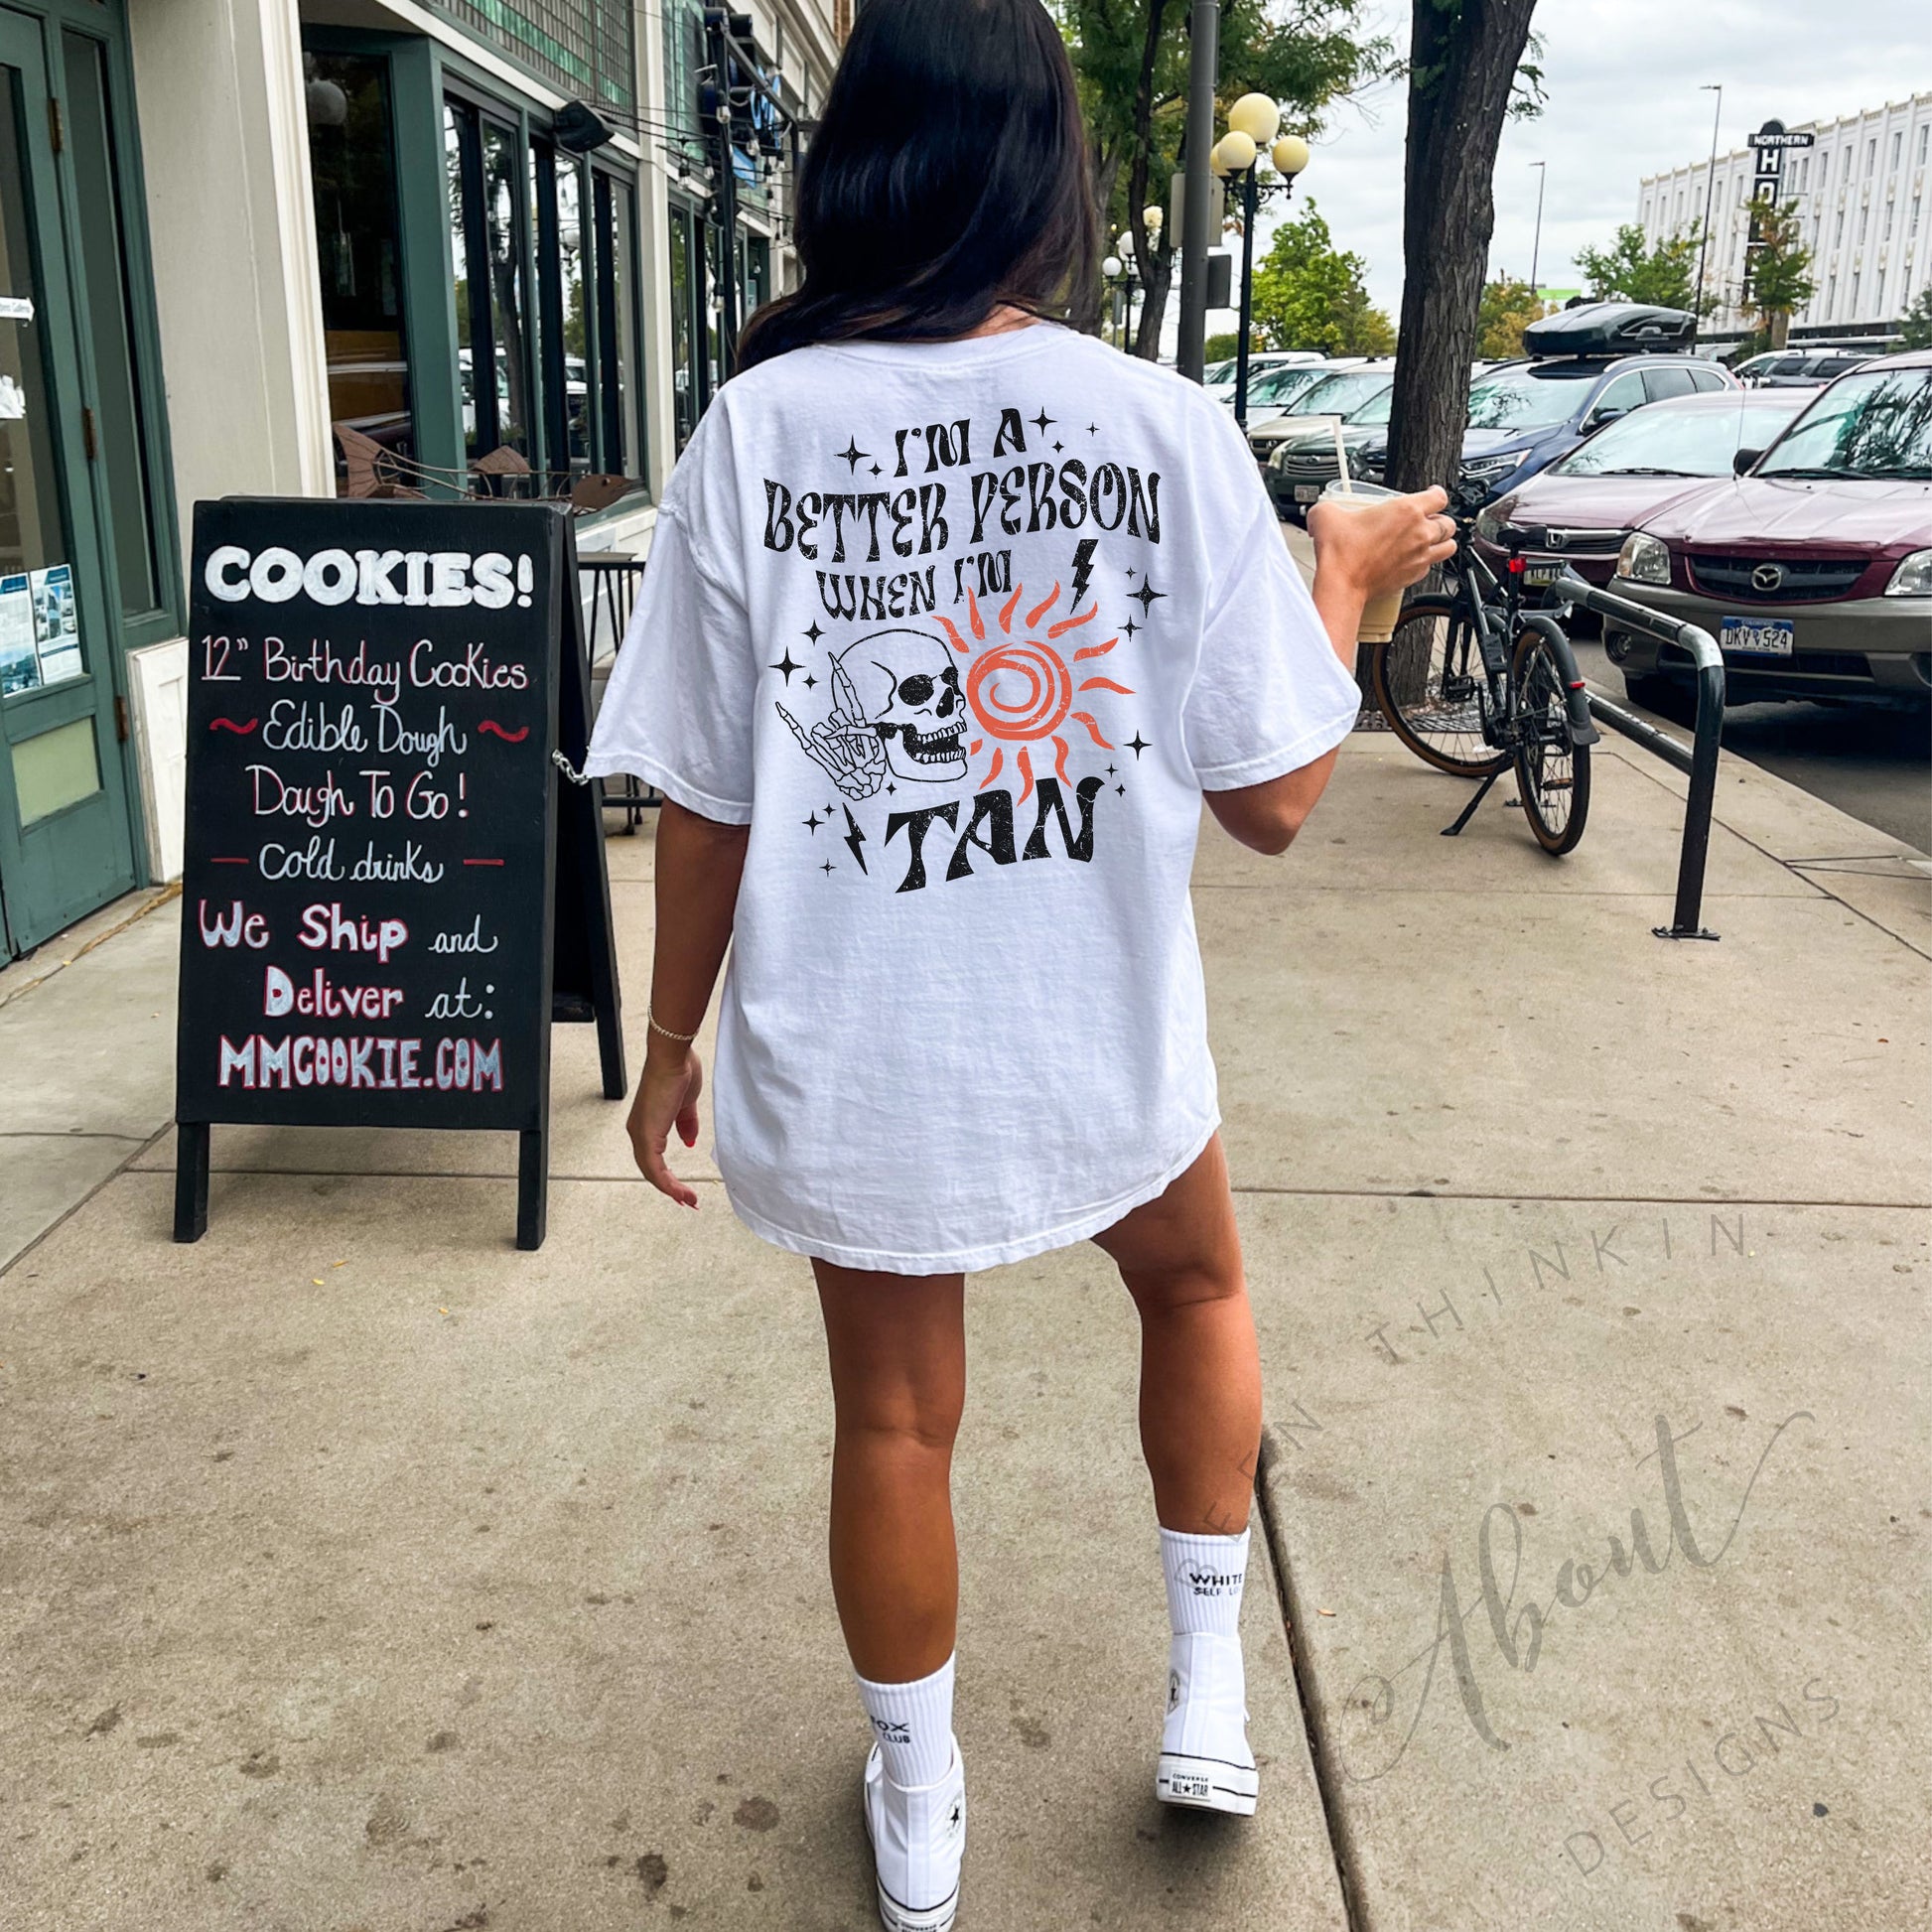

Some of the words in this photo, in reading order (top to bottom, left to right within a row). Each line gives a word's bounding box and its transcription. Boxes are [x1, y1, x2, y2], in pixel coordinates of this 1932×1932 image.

[1754, 135, 1809, 146] NORTHERN
[893, 419, 971, 478] I'M
[993, 408, 1027, 458] A
[763, 478, 949, 563] BETTER
[969, 459, 1161, 545] PERSON
[205, 546, 534, 609] COOKIES!
[816, 565, 935, 621] WHEN
[953, 549, 1012, 604] I'M
[1763, 629, 1787, 648] 524
[264, 636, 400, 704] Birthday
[262, 699, 367, 752] Edible
[370, 704, 468, 766] Dough
[245, 765, 354, 827] Dough
[359, 768, 394, 818] To
[259, 836, 345, 881] Cold
[884, 776, 1105, 893] TAN
[199, 898, 270, 949] We
[297, 902, 409, 963] Ship
[428, 913, 498, 954] and
[263, 965, 404, 1019] Deliver
[217, 1035, 503, 1090] MMCOOKIE.COM
[1192, 1587, 1221, 1596] SELF
[883, 1732, 910, 1743] CLUB
